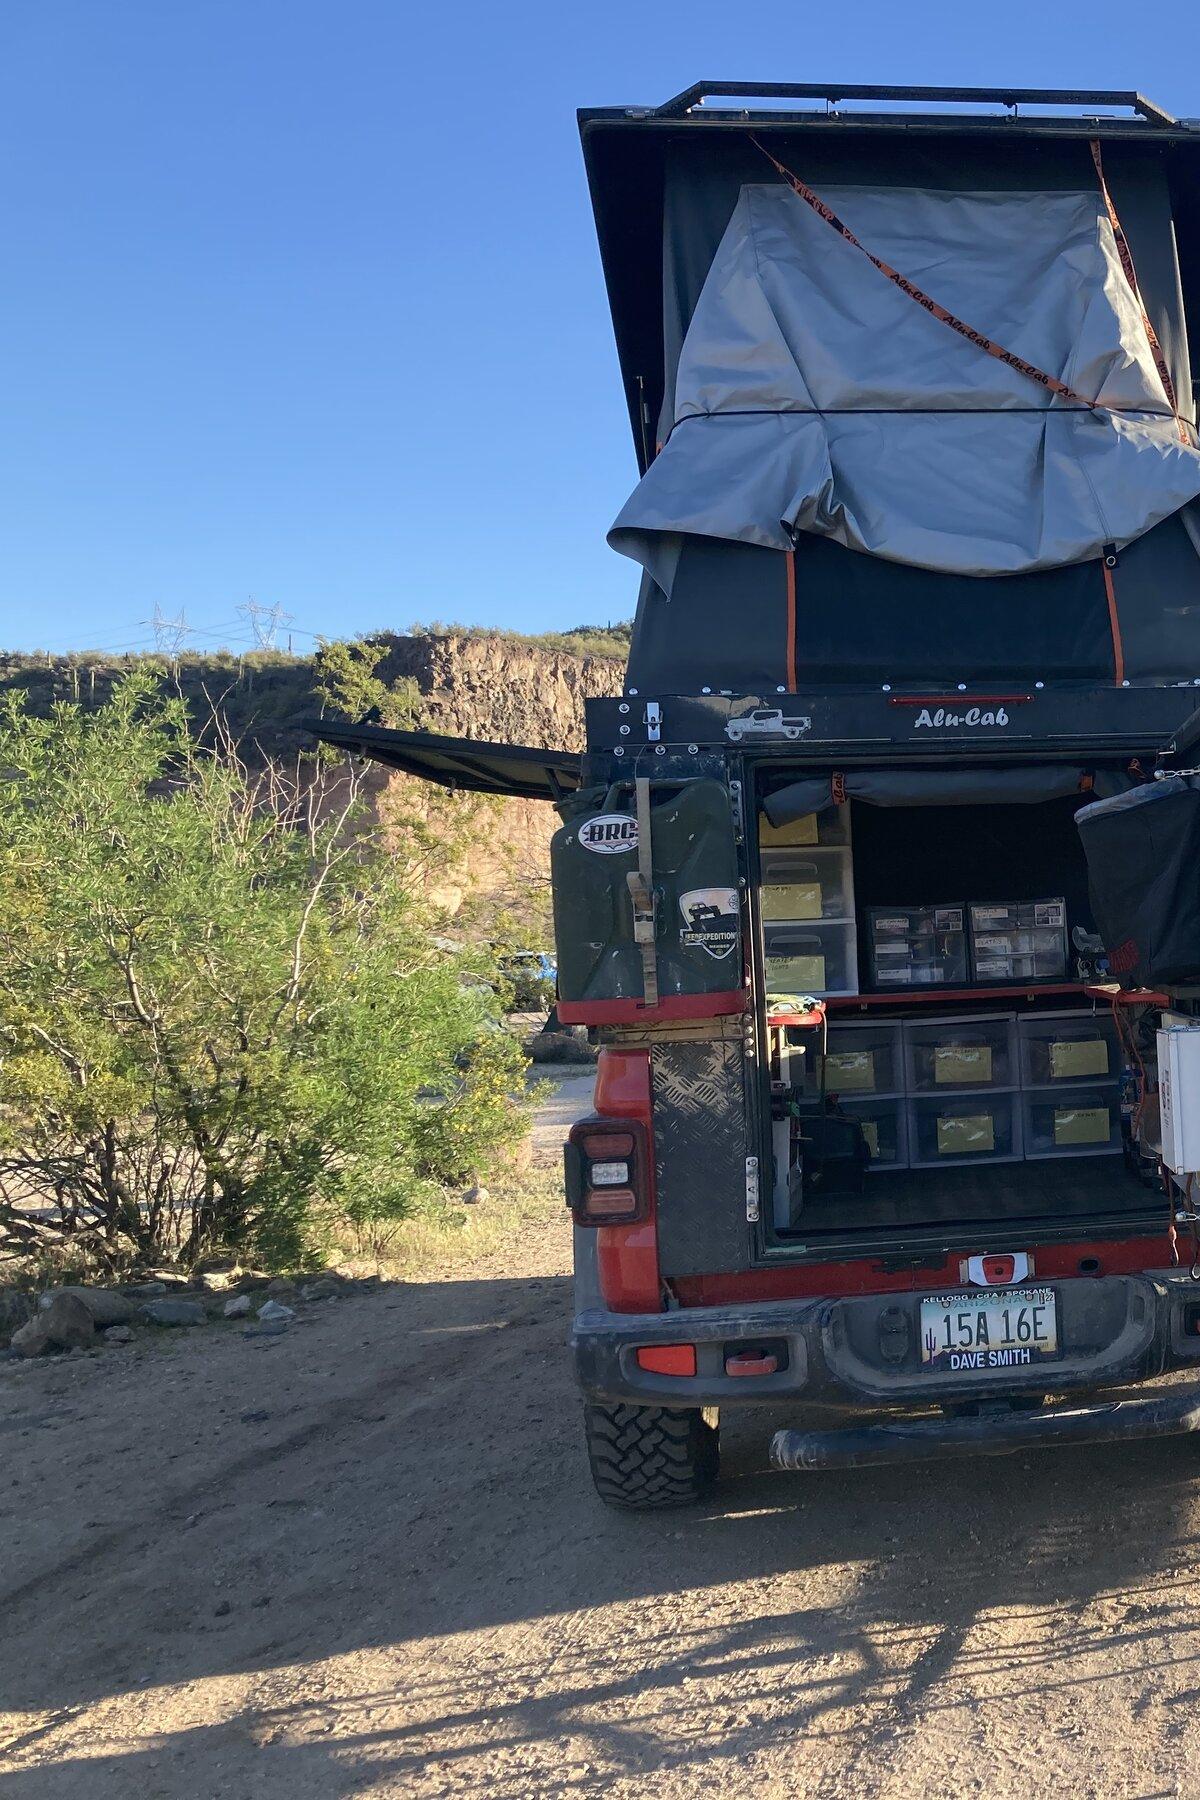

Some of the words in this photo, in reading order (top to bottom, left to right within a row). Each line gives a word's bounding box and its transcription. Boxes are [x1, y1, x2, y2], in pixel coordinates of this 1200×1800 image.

[943, 315, 990, 350] Alu-Cab
[1000, 352, 1049, 385] Alu-Cab
[914, 707, 1010, 728] Alu-Cab
[588, 822, 636, 842] BRC
[923, 1295, 968, 1304] KELLOGG
[1006, 1287, 1051, 1297] SPOKANE
[942, 1311, 990, 1349] 15A
[1001, 1306, 1048, 1344] 16E
[950, 1352, 986, 1370] DAVE
[988, 1348, 1031, 1367] SMITH
